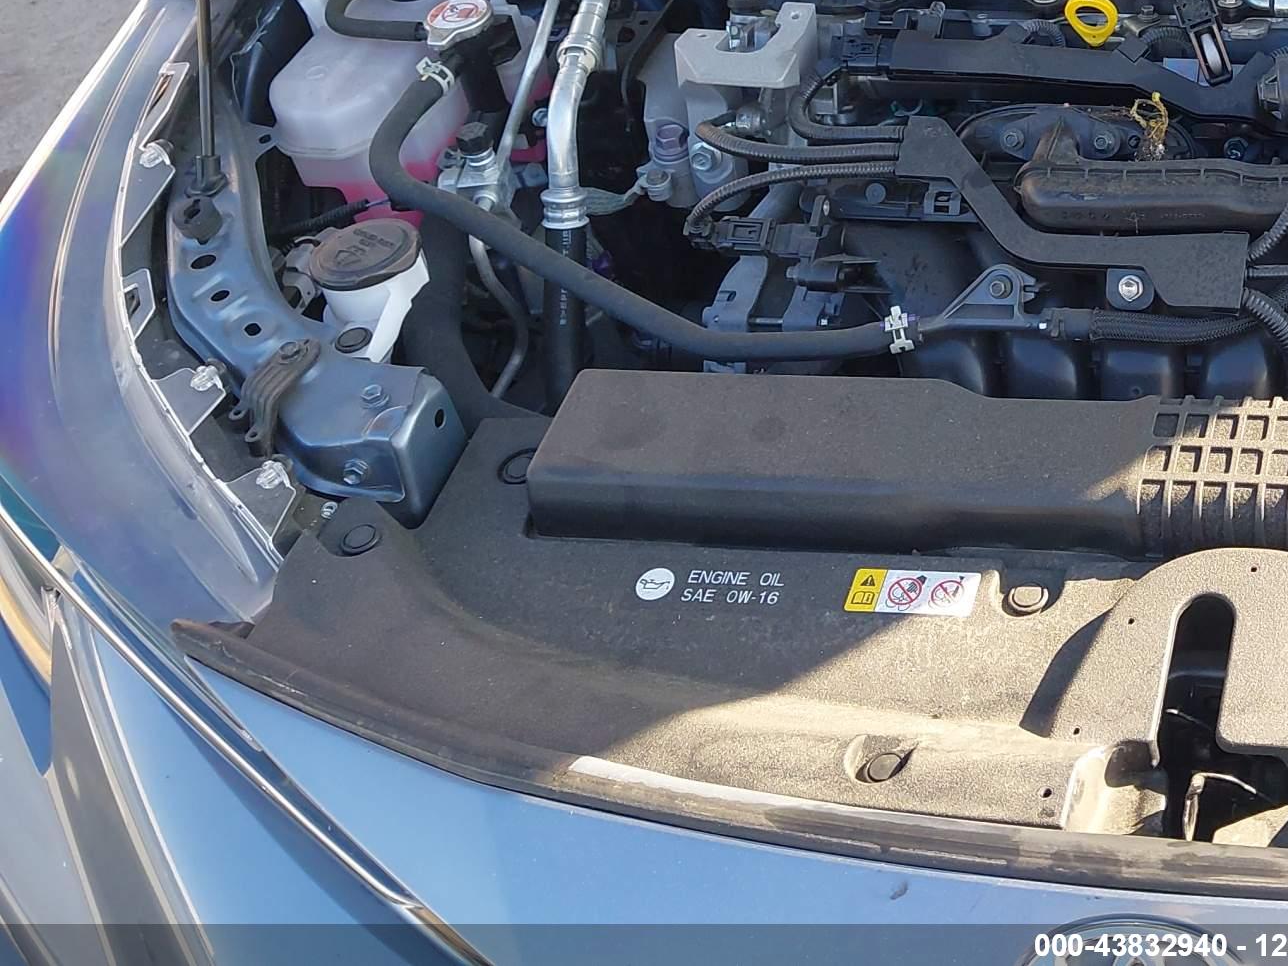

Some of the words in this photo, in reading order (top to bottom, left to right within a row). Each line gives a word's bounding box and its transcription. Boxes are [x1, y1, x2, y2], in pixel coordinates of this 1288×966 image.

[687, 569, 751, 586] ENGINE
[759, 572, 785, 587] OIL
[680, 588, 717, 603] SAE
[726, 590, 780, 605] 0W-16
